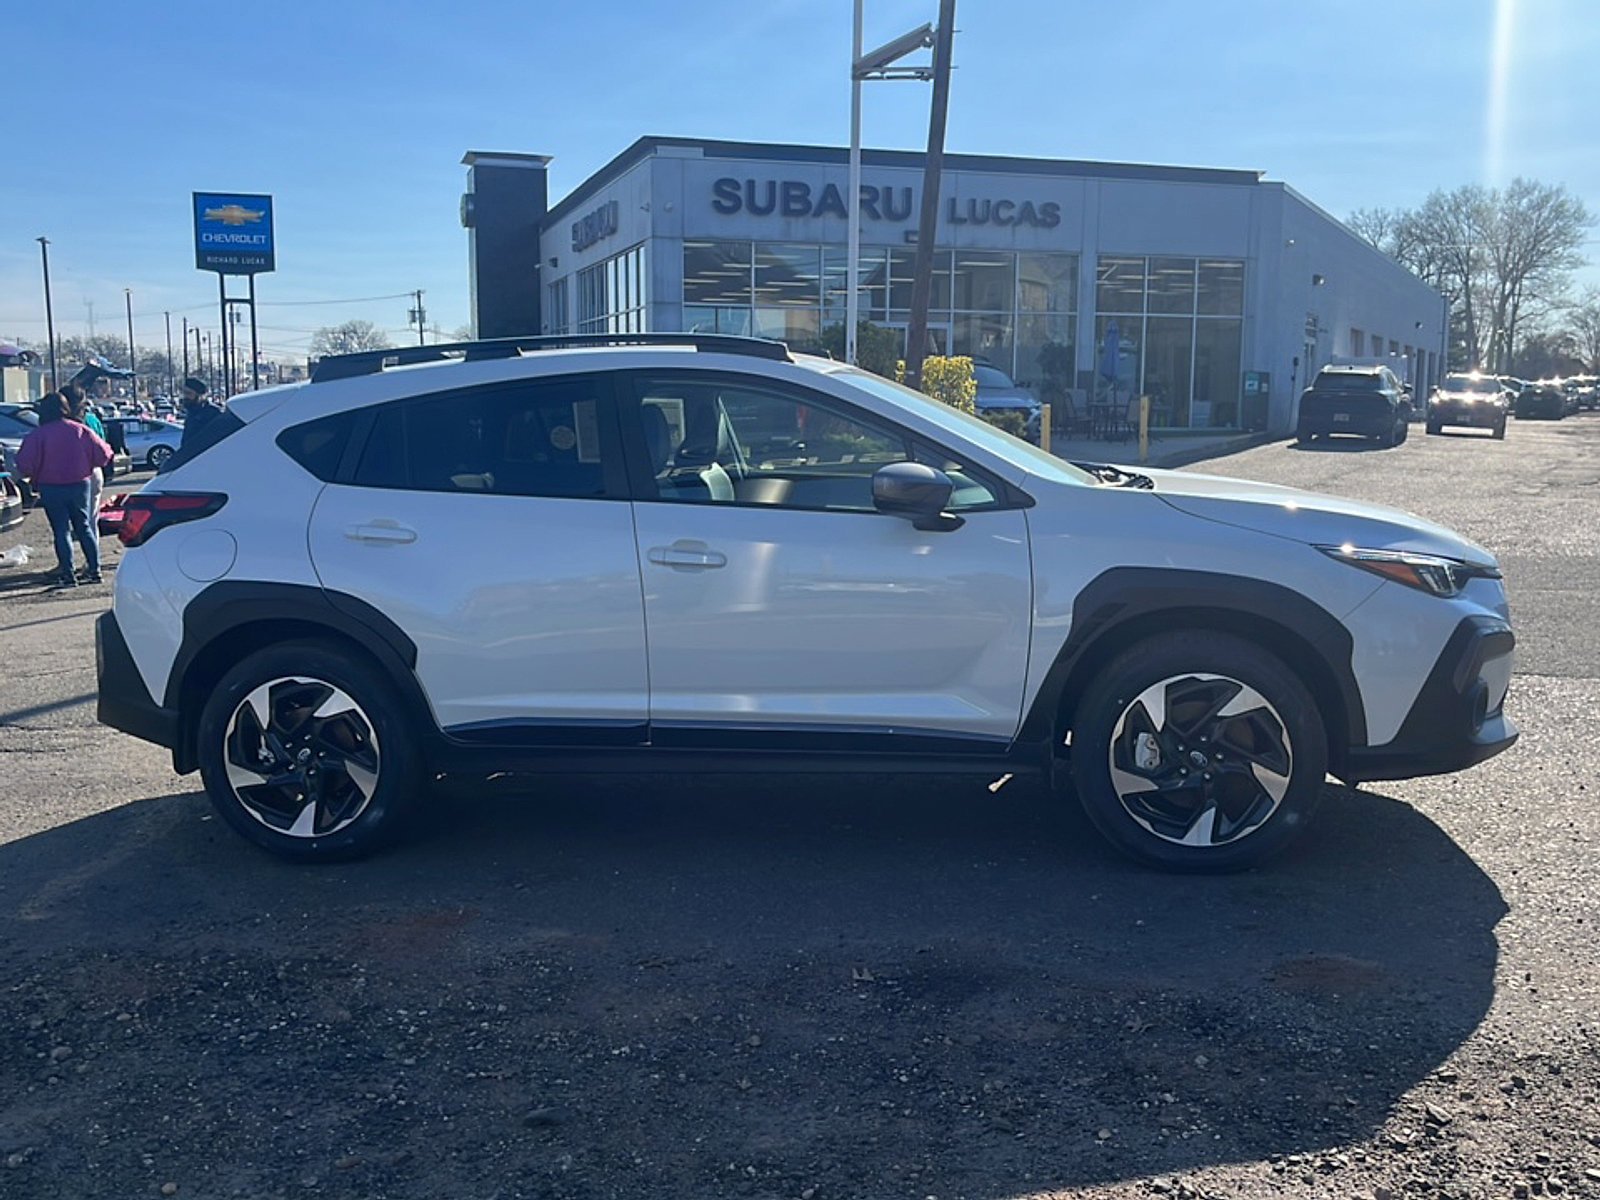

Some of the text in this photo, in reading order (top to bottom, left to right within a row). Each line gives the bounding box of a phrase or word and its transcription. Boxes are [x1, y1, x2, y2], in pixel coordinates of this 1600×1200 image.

[712, 177, 1061, 228] SUBARU LUCAS
[202, 233, 266, 244] CHEVROLET
[572, 200, 618, 252] SUBARU
[207, 256, 265, 265] RICHARD LUCAS
